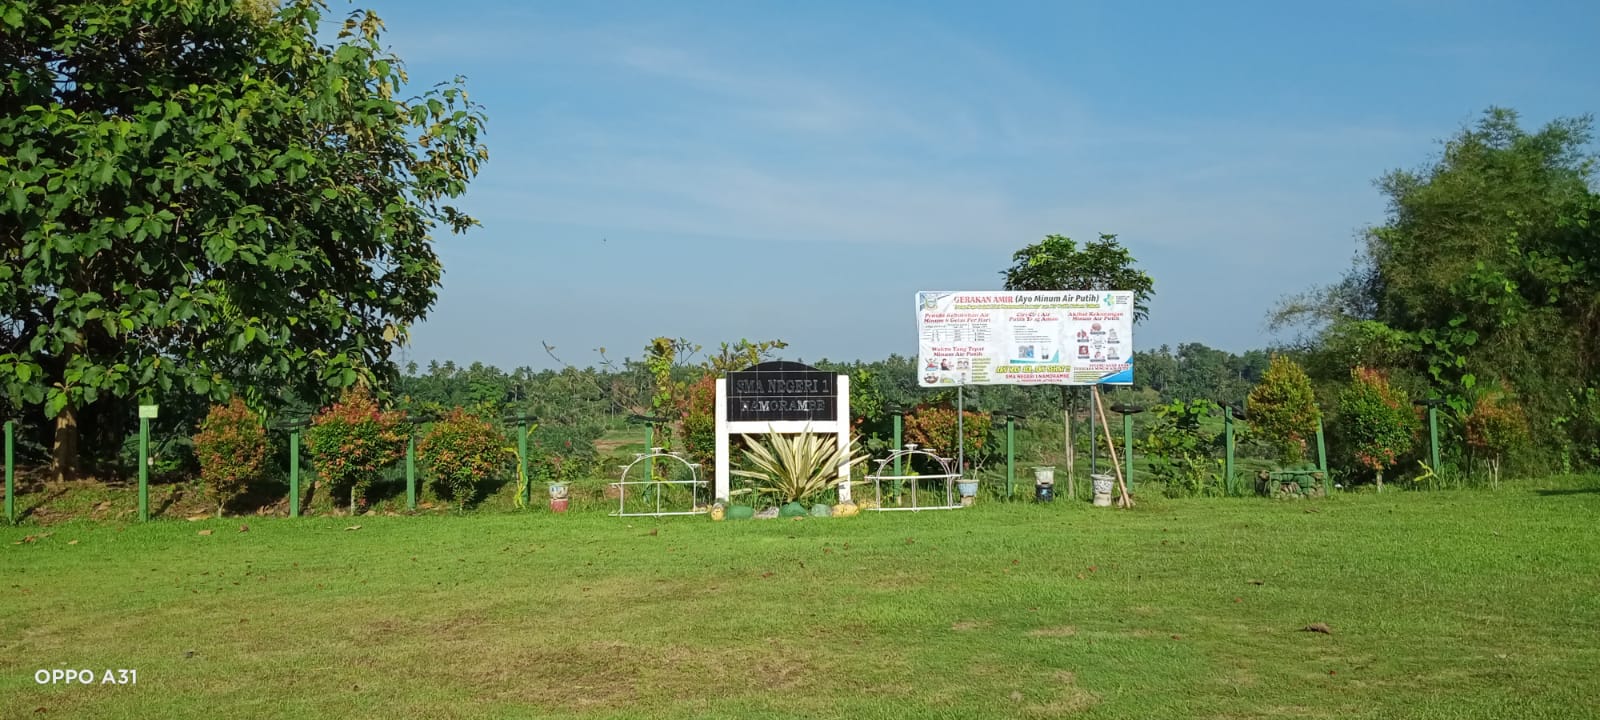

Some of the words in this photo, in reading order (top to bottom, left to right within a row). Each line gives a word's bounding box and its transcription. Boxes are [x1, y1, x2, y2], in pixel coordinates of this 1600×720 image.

[954, 295, 992, 304] GERAKAN
[993, 295, 1014, 304] AMIR
[1015, 294, 1033, 305] (Ayo
[1034, 294, 1061, 303] Minum
[1062, 294, 1074, 303] Air
[1075, 294, 1100, 303] Putih)
[736, 379, 765, 394] SMA
[767, 379, 818, 394] NEGERI
[822, 379, 829, 393] 1
[740, 400, 826, 412] NAMORAMBE
